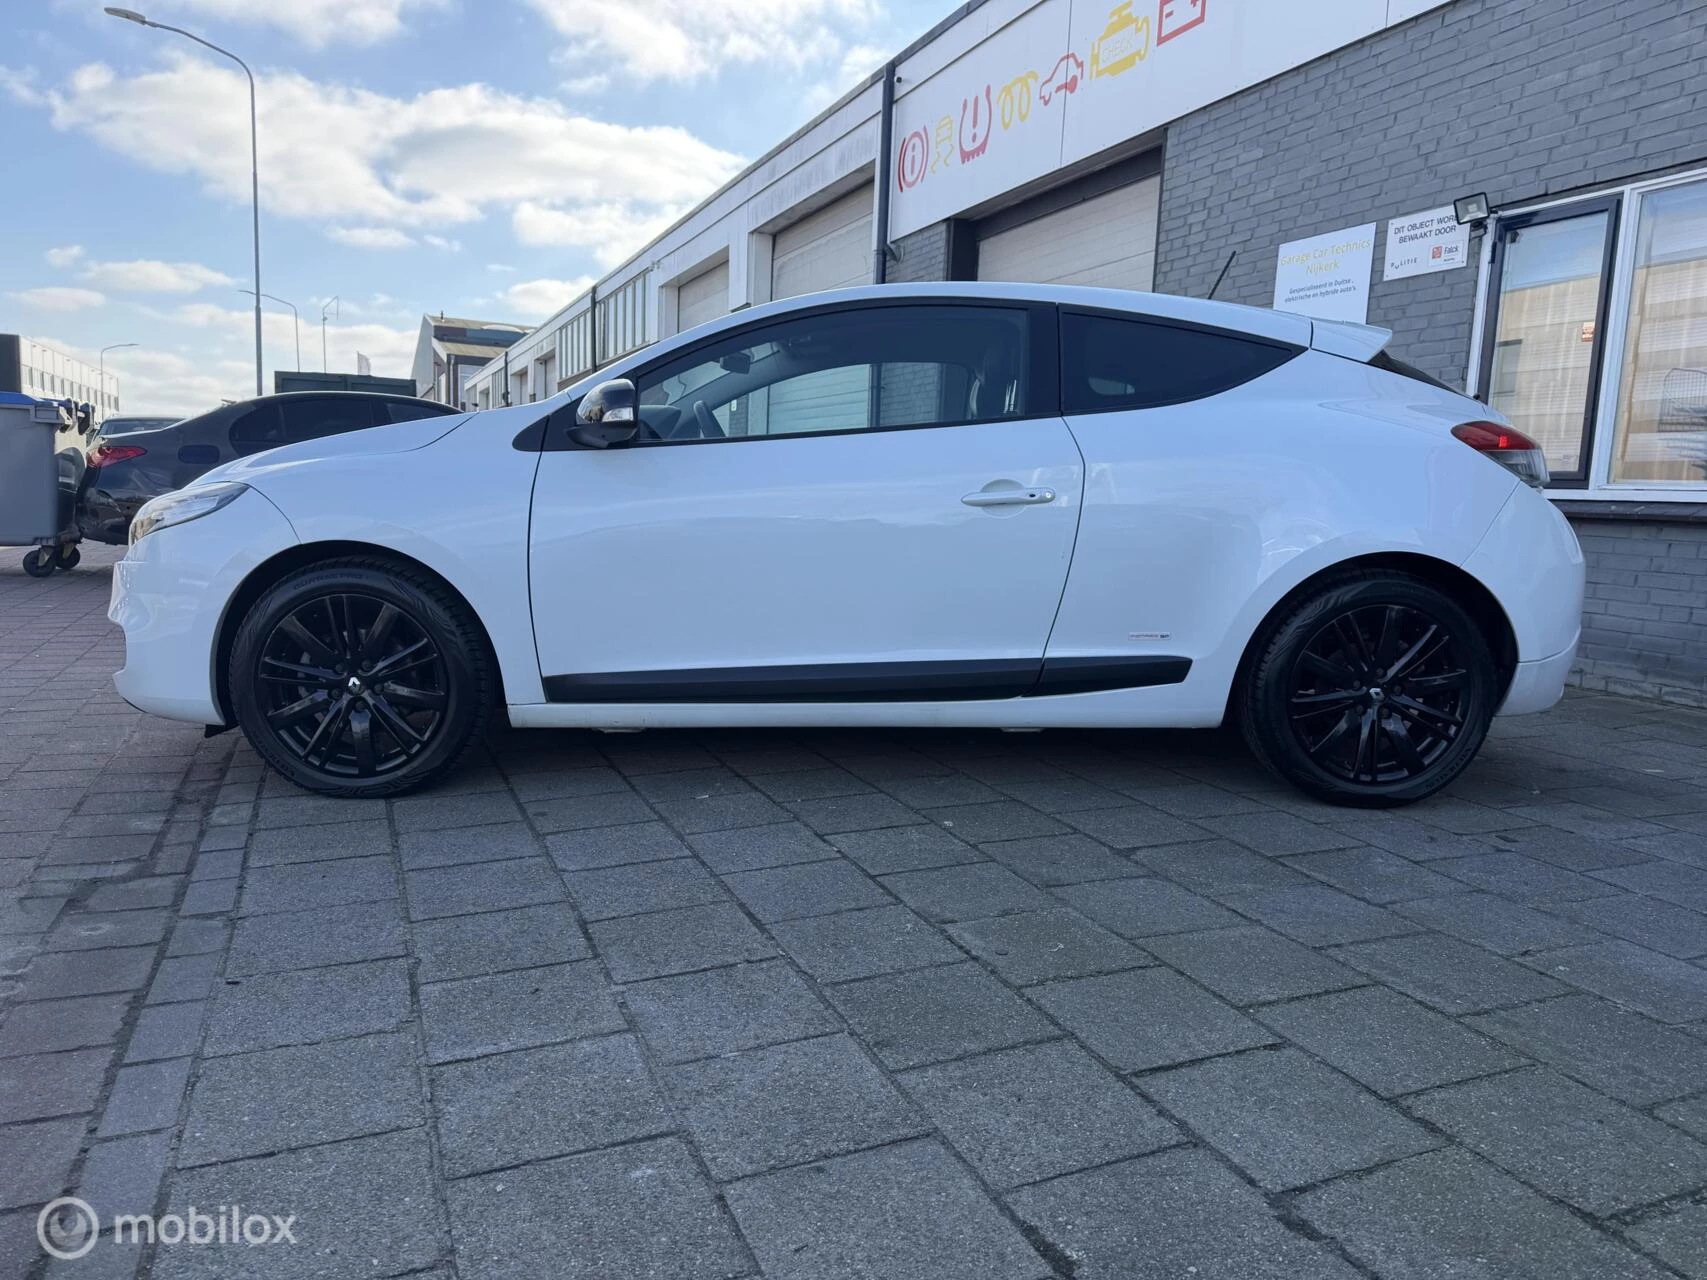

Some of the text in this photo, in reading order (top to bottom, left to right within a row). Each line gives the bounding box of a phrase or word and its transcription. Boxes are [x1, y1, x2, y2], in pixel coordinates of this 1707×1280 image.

[1394, 225, 1405, 235] DIT
[1407, 219, 1435, 232] OBJECT
[1399, 225, 1457, 244] BEWAAKT DOOR
[1280, 239, 1371, 266] Garage Car Technics
[1306, 259, 1340, 276] Nijkerk
